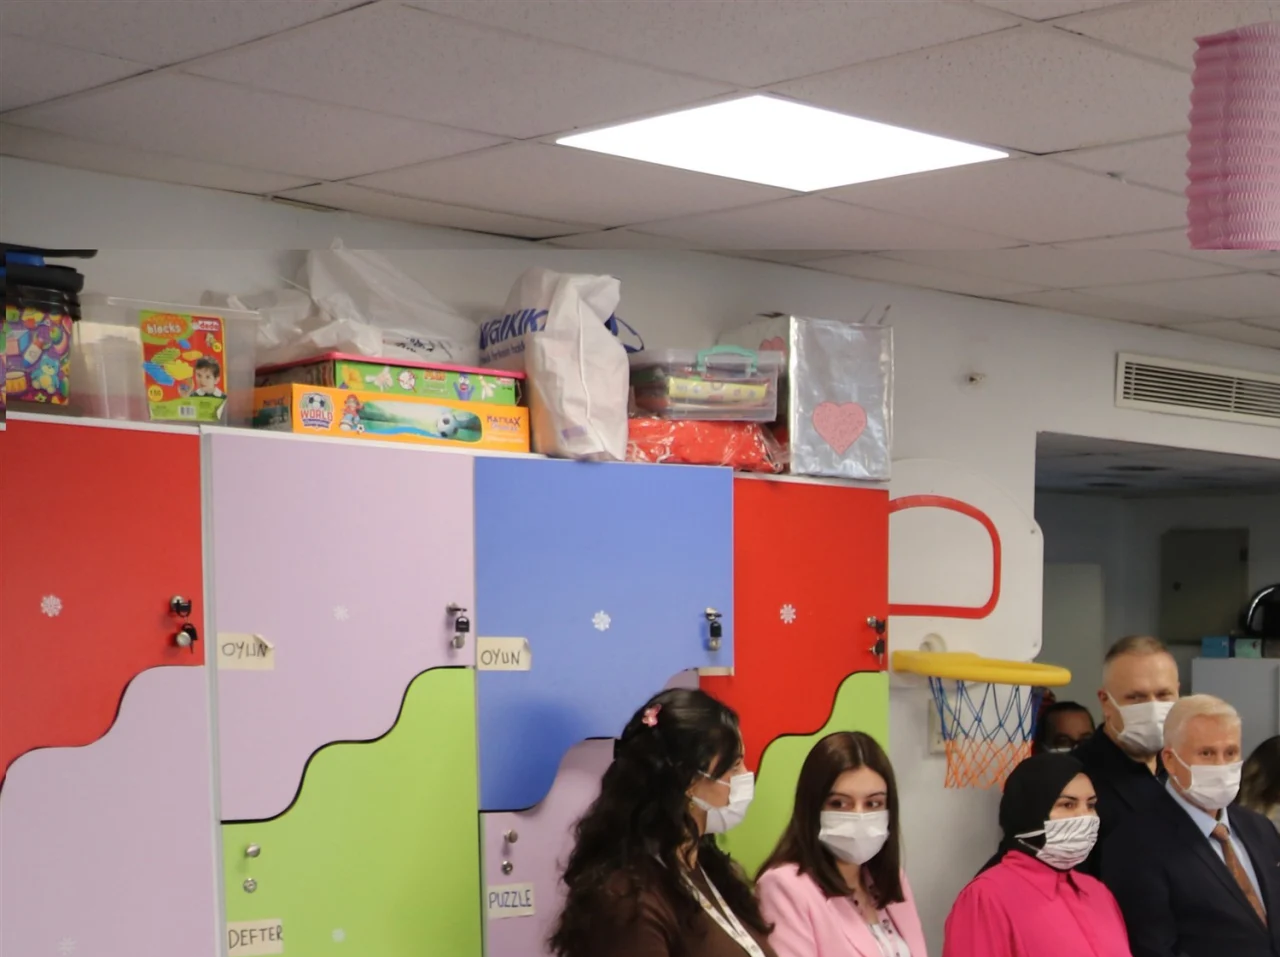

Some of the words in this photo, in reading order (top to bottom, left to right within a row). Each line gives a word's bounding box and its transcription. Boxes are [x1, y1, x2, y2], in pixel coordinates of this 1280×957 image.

[146, 323, 181, 334] blocks
[300, 409, 333, 421] WORLD
[221, 641, 269, 659] OYUN
[481, 648, 521, 666] OYUN
[488, 889, 532, 909] PUZZLE
[228, 924, 284, 950] DEFTER
